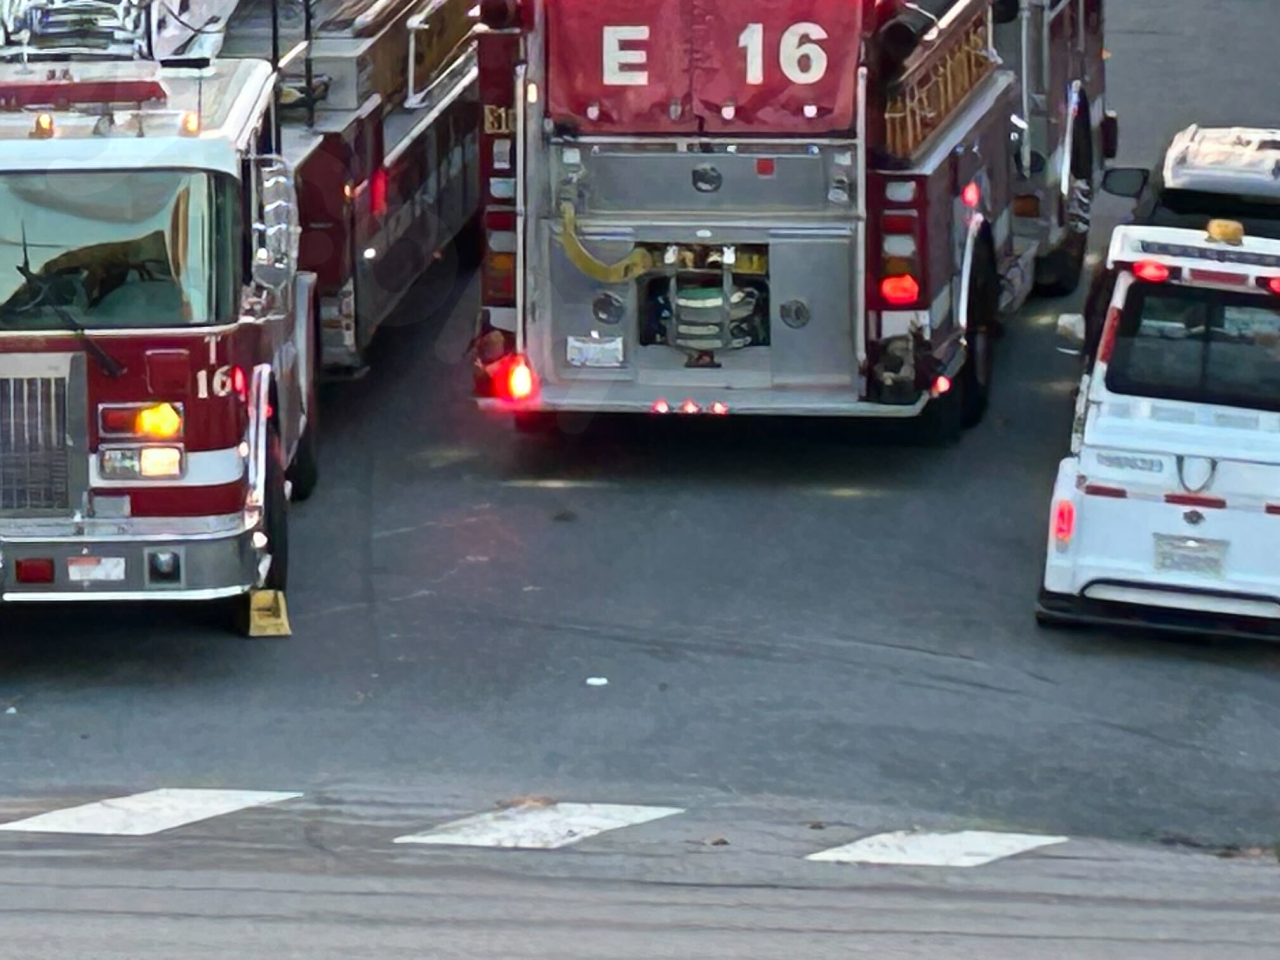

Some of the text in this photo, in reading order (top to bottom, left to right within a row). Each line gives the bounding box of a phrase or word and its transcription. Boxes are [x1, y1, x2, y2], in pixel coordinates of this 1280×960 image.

[602, 21, 829, 86] E 16
[204, 335, 222, 365] T
[196, 365, 233, 399] 16
